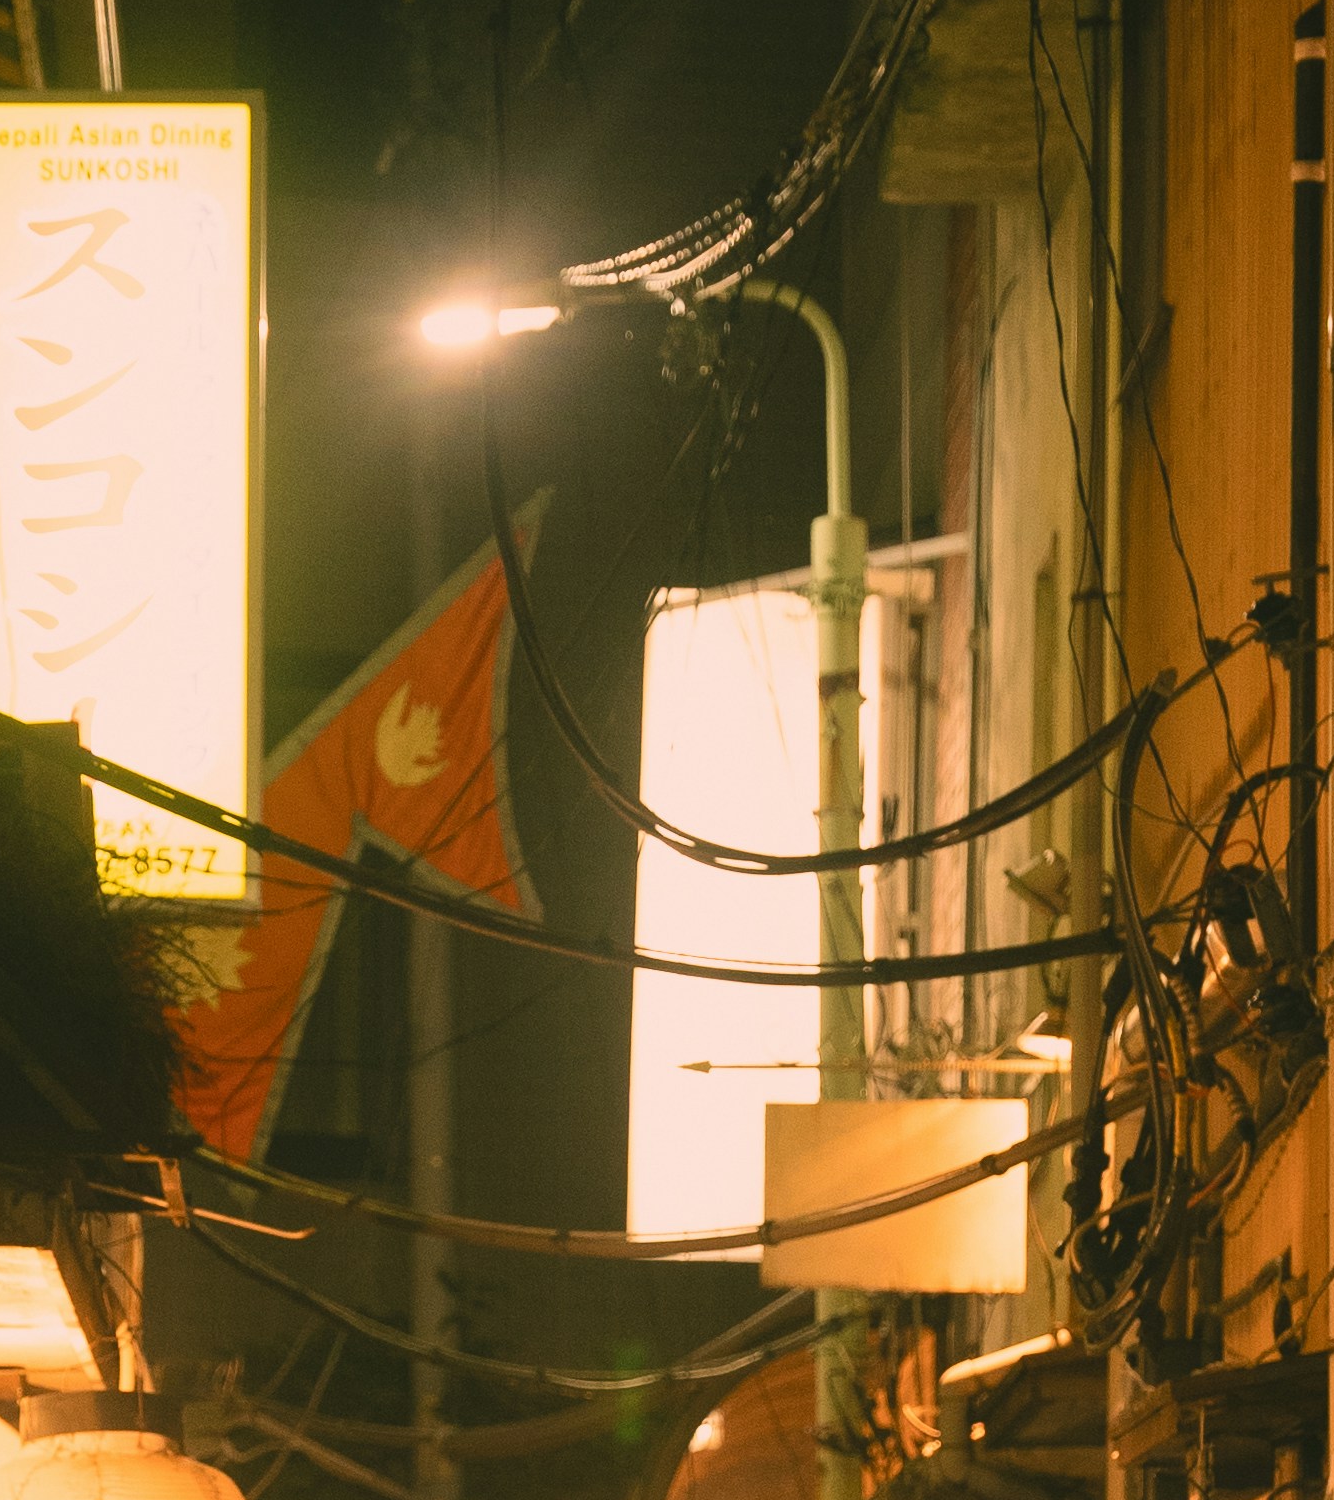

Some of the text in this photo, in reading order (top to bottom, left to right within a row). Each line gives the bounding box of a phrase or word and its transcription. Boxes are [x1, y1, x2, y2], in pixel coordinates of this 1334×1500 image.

[69, 124, 140, 146] Asian
[151, 124, 233, 149] Dining
[38, 158, 179, 181] SUNKOSHI
